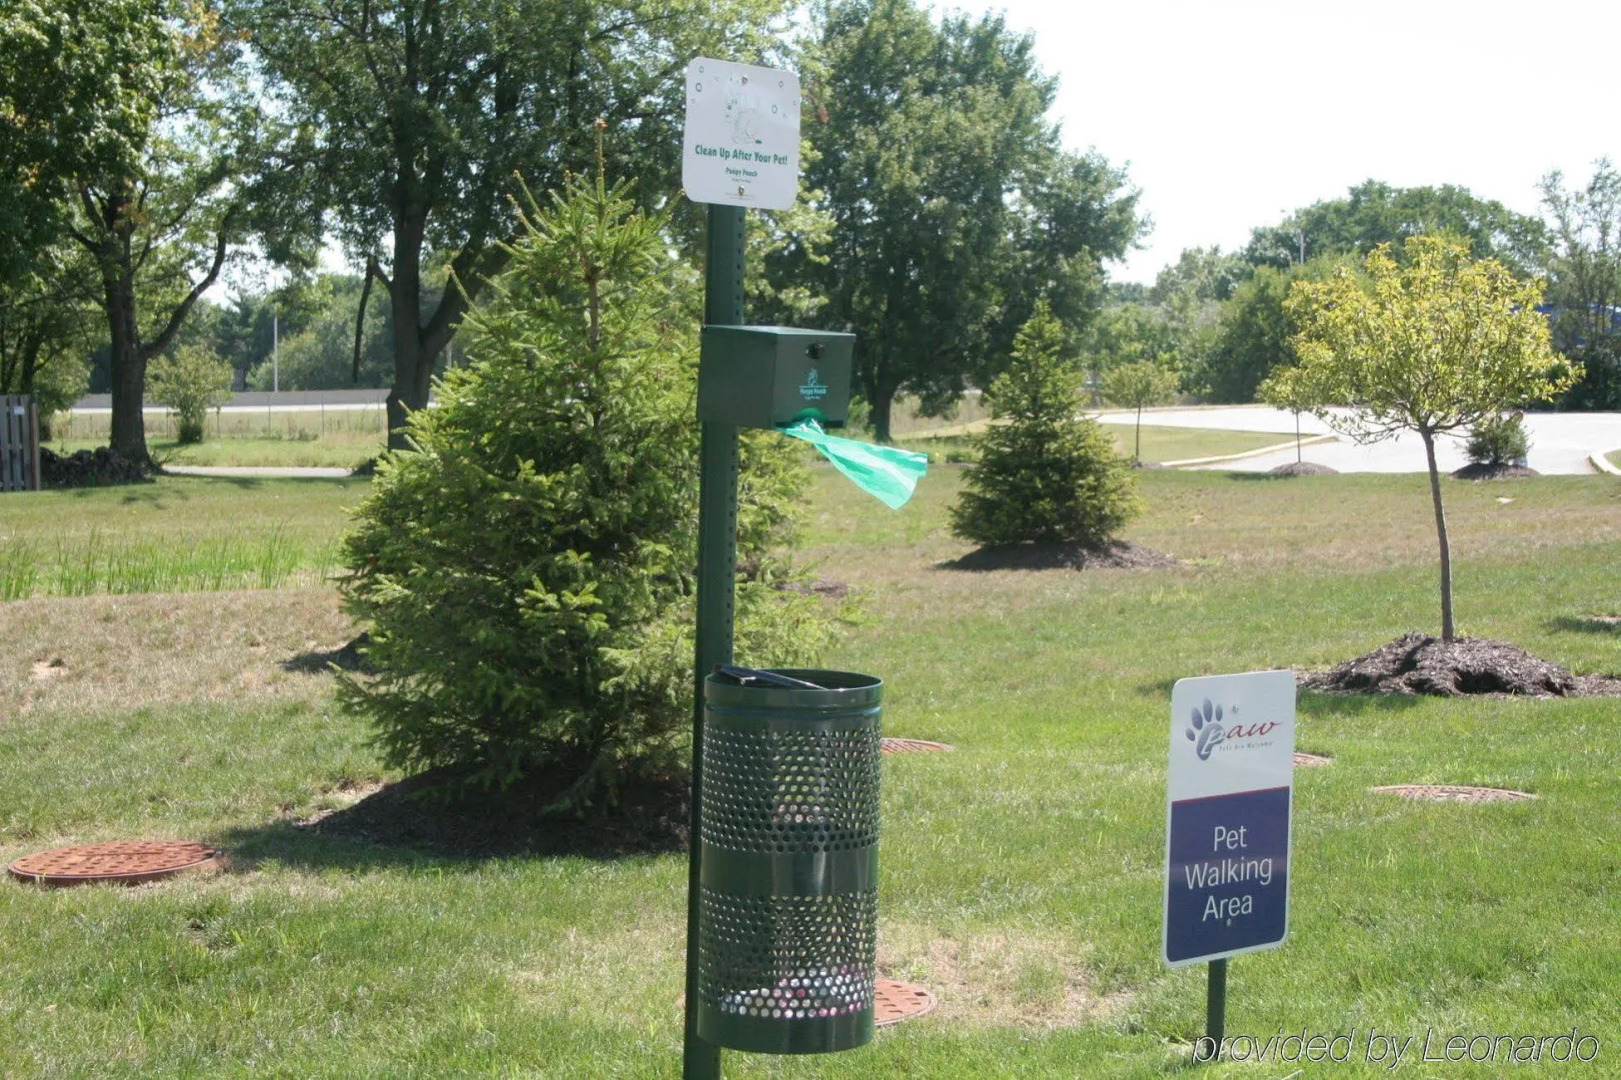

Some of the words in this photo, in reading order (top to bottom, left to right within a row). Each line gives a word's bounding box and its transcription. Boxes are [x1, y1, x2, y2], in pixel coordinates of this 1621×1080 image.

[695, 145, 717, 157] Clean
[719, 147, 730, 160] Up
[732, 149, 752, 161] After
[754, 152, 771, 163] Your
[773, 154, 788, 165] Pet!
[1214, 825, 1248, 851] Pet
[1185, 857, 1273, 890] Walking
[1202, 895, 1252, 922] Area
